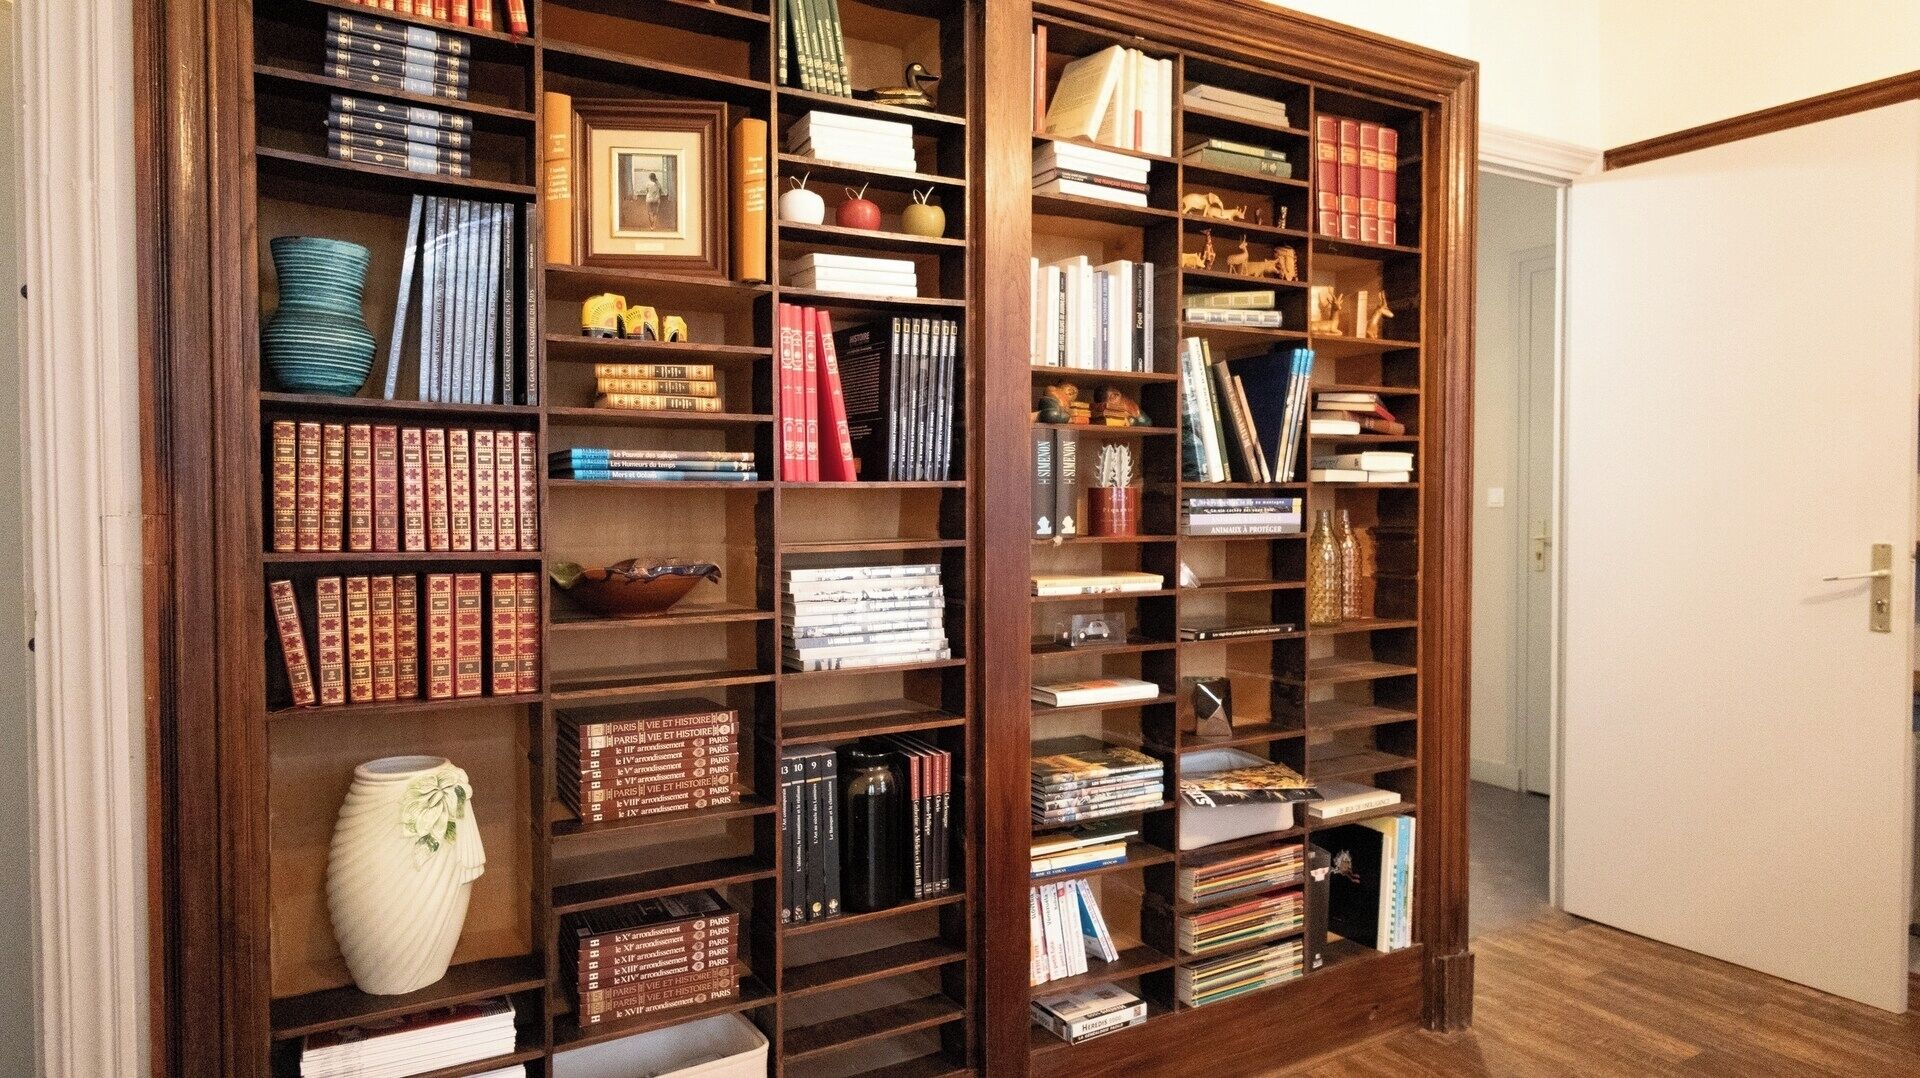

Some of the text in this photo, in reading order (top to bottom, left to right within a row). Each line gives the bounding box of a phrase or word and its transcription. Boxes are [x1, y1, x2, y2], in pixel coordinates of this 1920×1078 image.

[1038, 441, 1050, 477] SIMENON
[1063, 441, 1076, 477] SIMENON
[1243, 525, 1247, 533] À
[1249, 525, 1282, 533] PROTÉGER
[613, 716, 712, 733] PARIS VIE ET HISTOIRE
[614, 728, 712, 745] PARIS VIE ET HISTOIRE
[637, 741, 685, 753] arrondissement
[709, 736, 729, 744] PARIS
[634, 752, 682, 763] arrondissement
[709, 746, 729, 754] PARIS
[634, 762, 682, 774] arrondissement
[710, 756, 730, 765] PARIS
[637, 772, 685, 783] arrondissement
[709, 766, 729, 774] PARIS
[781, 766, 788, 774] 13
[794, 763, 803, 772] 10
[613, 788, 638, 798] PARIS
[647, 785, 662, 793] VIE
[676, 778, 712, 789] HISTOIRE
[641, 792, 689, 805] arrondissement
[709, 786, 729, 794] PARIS
[641, 802, 689, 815] arrondissement
[711, 797, 731, 805] PARIS
[924, 797, 932, 835] Louis-Philippe
[942, 793, 950, 828] Charlemagne
[632, 926, 680, 940] arrondissement
[710, 917, 729, 926] PARIS
[635, 936, 684, 950] arrondissement
[710, 927, 729, 936] PARIS
[637, 946, 685, 960] arrondissement
[708, 937, 729, 948] PARIS
[640, 956, 687, 971] arrondissement
[708, 948, 728, 957] PARIS
[640, 966, 688, 980] arrondissement
[708, 958, 729, 967] PARIS
[612, 987, 637, 997] PARIS
[646, 982, 661, 990] VIE
[675, 972, 712, 984] HISTOIRE
[613, 998, 638, 1008] PARIS
[647, 993, 661, 1002] VIE
[676, 983, 712, 995] HISTOIRE
[645, 998, 694, 1012] arrondissement
[711, 989, 731, 999] PARIS
